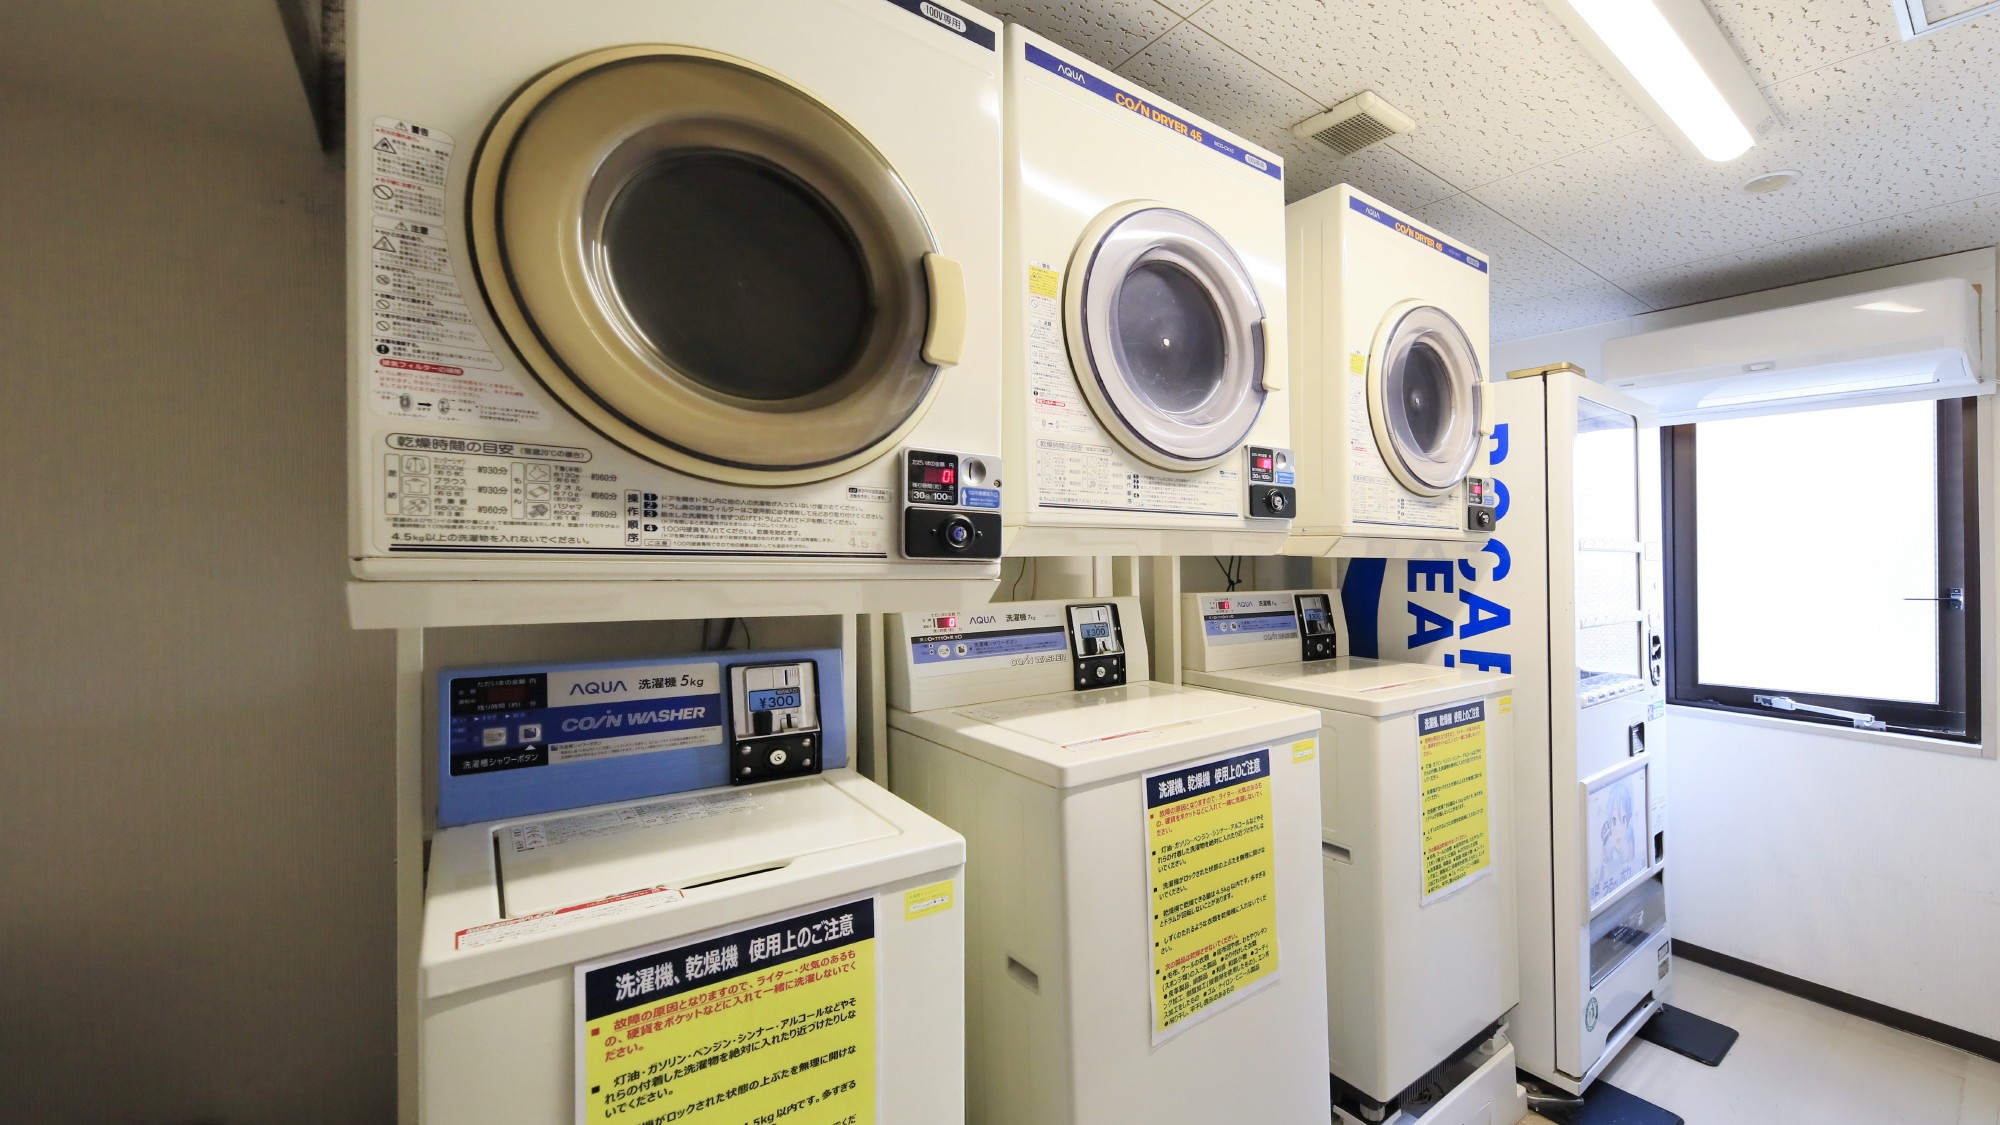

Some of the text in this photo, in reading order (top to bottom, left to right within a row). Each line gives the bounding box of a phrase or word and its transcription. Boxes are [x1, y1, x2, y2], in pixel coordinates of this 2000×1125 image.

[925, 4, 961, 30] 100V専用
[1057, 64, 1086, 84] AQUA
[1152, 110, 1188, 136] DRYER
[1189, 129, 1203, 143] 45
[1365, 207, 1381, 219] AQUA
[411, 224, 429, 236] 注意
[1415, 231, 1435, 248] DRYER
[1435, 243, 1443, 252] 45
[397, 435, 514, 456] 乾燥時間の目安
[478, 465, 508, 476] 約30分
[591, 473, 617, 482] 約60分
[478, 485, 508, 495] 約30分
[591, 491, 618, 500] 約60分
[933, 492, 953, 501] 100円
[478, 505, 508, 515] 約60分
[591, 510, 617, 519] 約60分
[627, 493, 639, 543] 操作順序
[391, 532, 591, 545] 4.5kg以上の洗濯物を入れないでください。
[969, 615, 996, 625] AQUA
[1005, 613, 1027, 622] 洗濯機
[1086, 628, 1105, 637] ¥300
[1034, 654, 1067, 664] WASHER
[529, 677, 537, 685] 円
[569, 674, 704, 696] AQUA 洗濯機 5kg
[760, 695, 794, 708] ¥300
[628, 706, 706, 725] WASHER
[462, 753, 539, 770] 洗濯槽シャワーボタン
[1158, 757, 1261, 799] 洗濯機、乾燥機 使用上のご注意
[615, 944, 739, 1002] 洗濯機、乾燥機
[748, 913, 854, 963] 使用上のご注意
[613, 949, 856, 1031] 故障の原因となりますので、ライター・火気のあるも
[604, 962, 857, 1047] の、硬貨をポケットなどに入れて一緒に洗濯しないでく
[613, 997, 857, 1088] 灯油・ガソリン・ベンジン・シンナー・アルコールなどやそ
[604, 1045, 644, 1062] ださい。
[604, 1009, 857, 1105] れらの付着した洗濯物を絶対に入れたり近づけたりしな
[604, 1088, 674, 1119] いでください。
